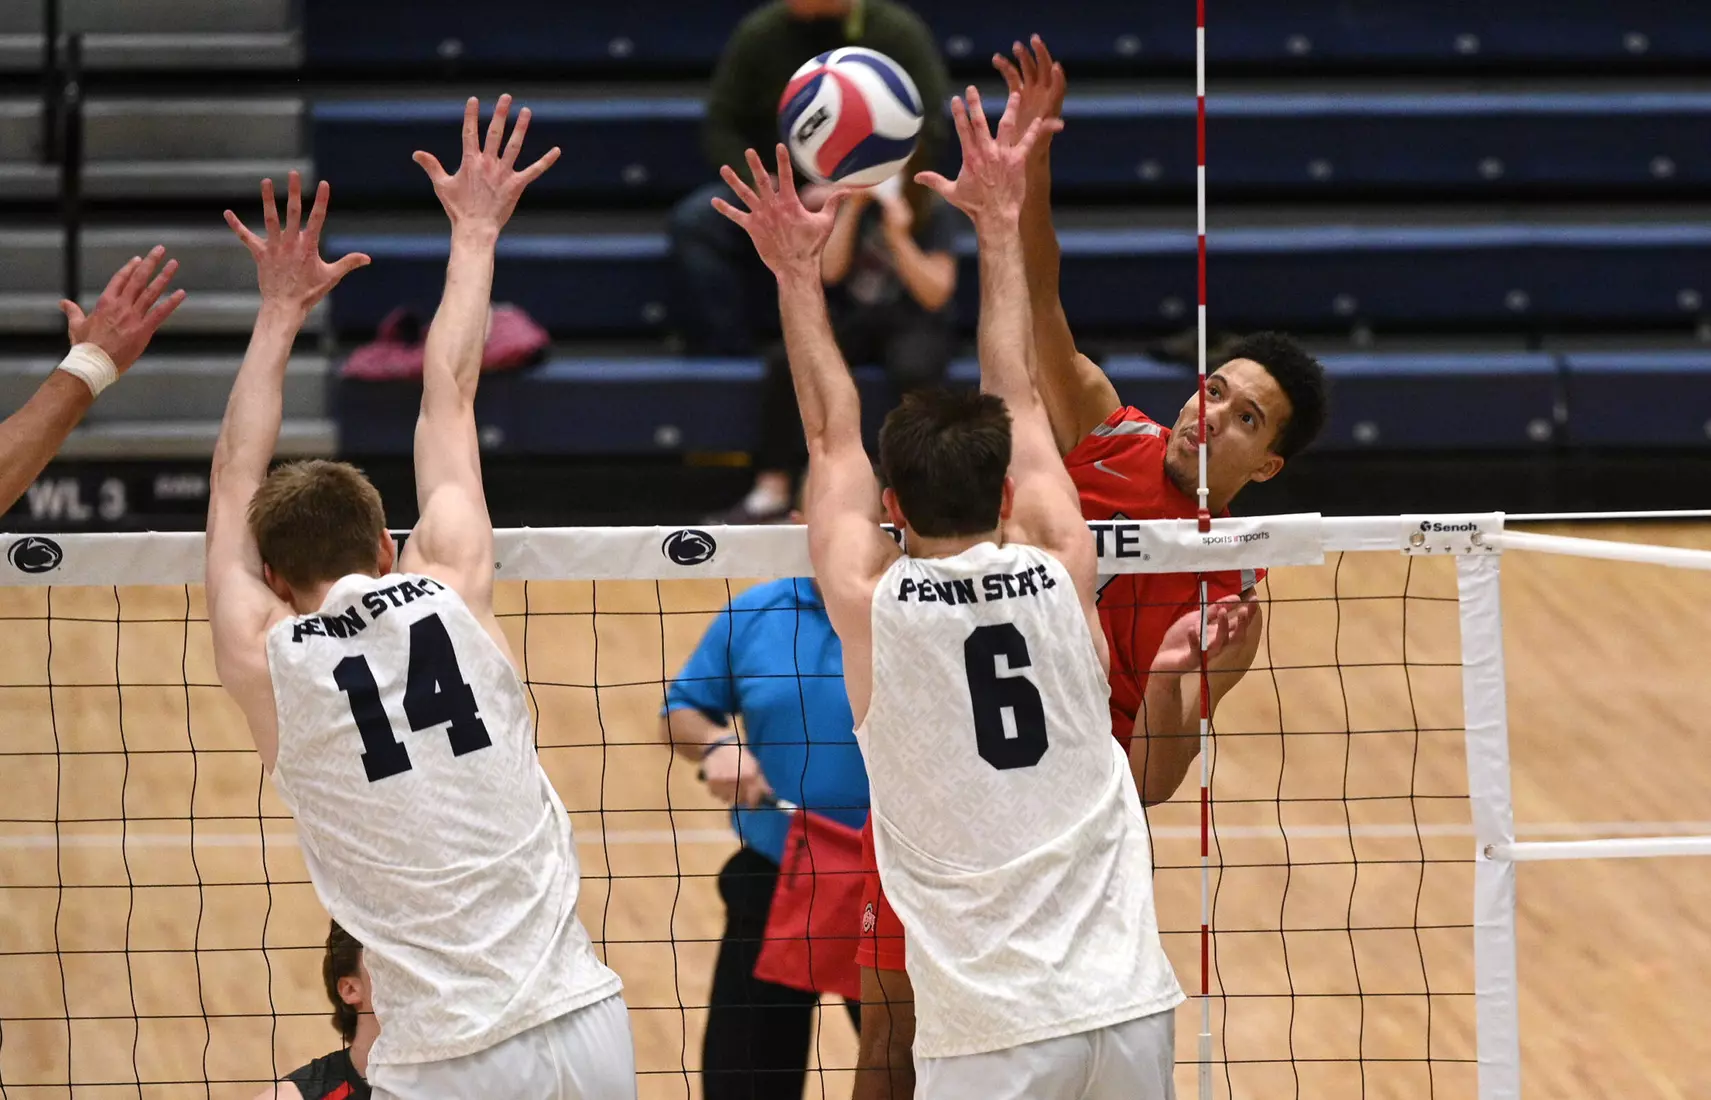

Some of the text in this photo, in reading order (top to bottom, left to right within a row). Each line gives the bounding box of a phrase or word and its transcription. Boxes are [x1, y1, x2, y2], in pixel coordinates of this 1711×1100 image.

[1087, 523, 1141, 558] TE
[1202, 531, 1270, 545] sports imports
[1433, 522, 1477, 532] Senoh
[898, 564, 1056, 605] PENN STAE
[292, 577, 445, 643] PENN STA
[332, 612, 492, 783] 14
[964, 622, 1049, 771] 6
